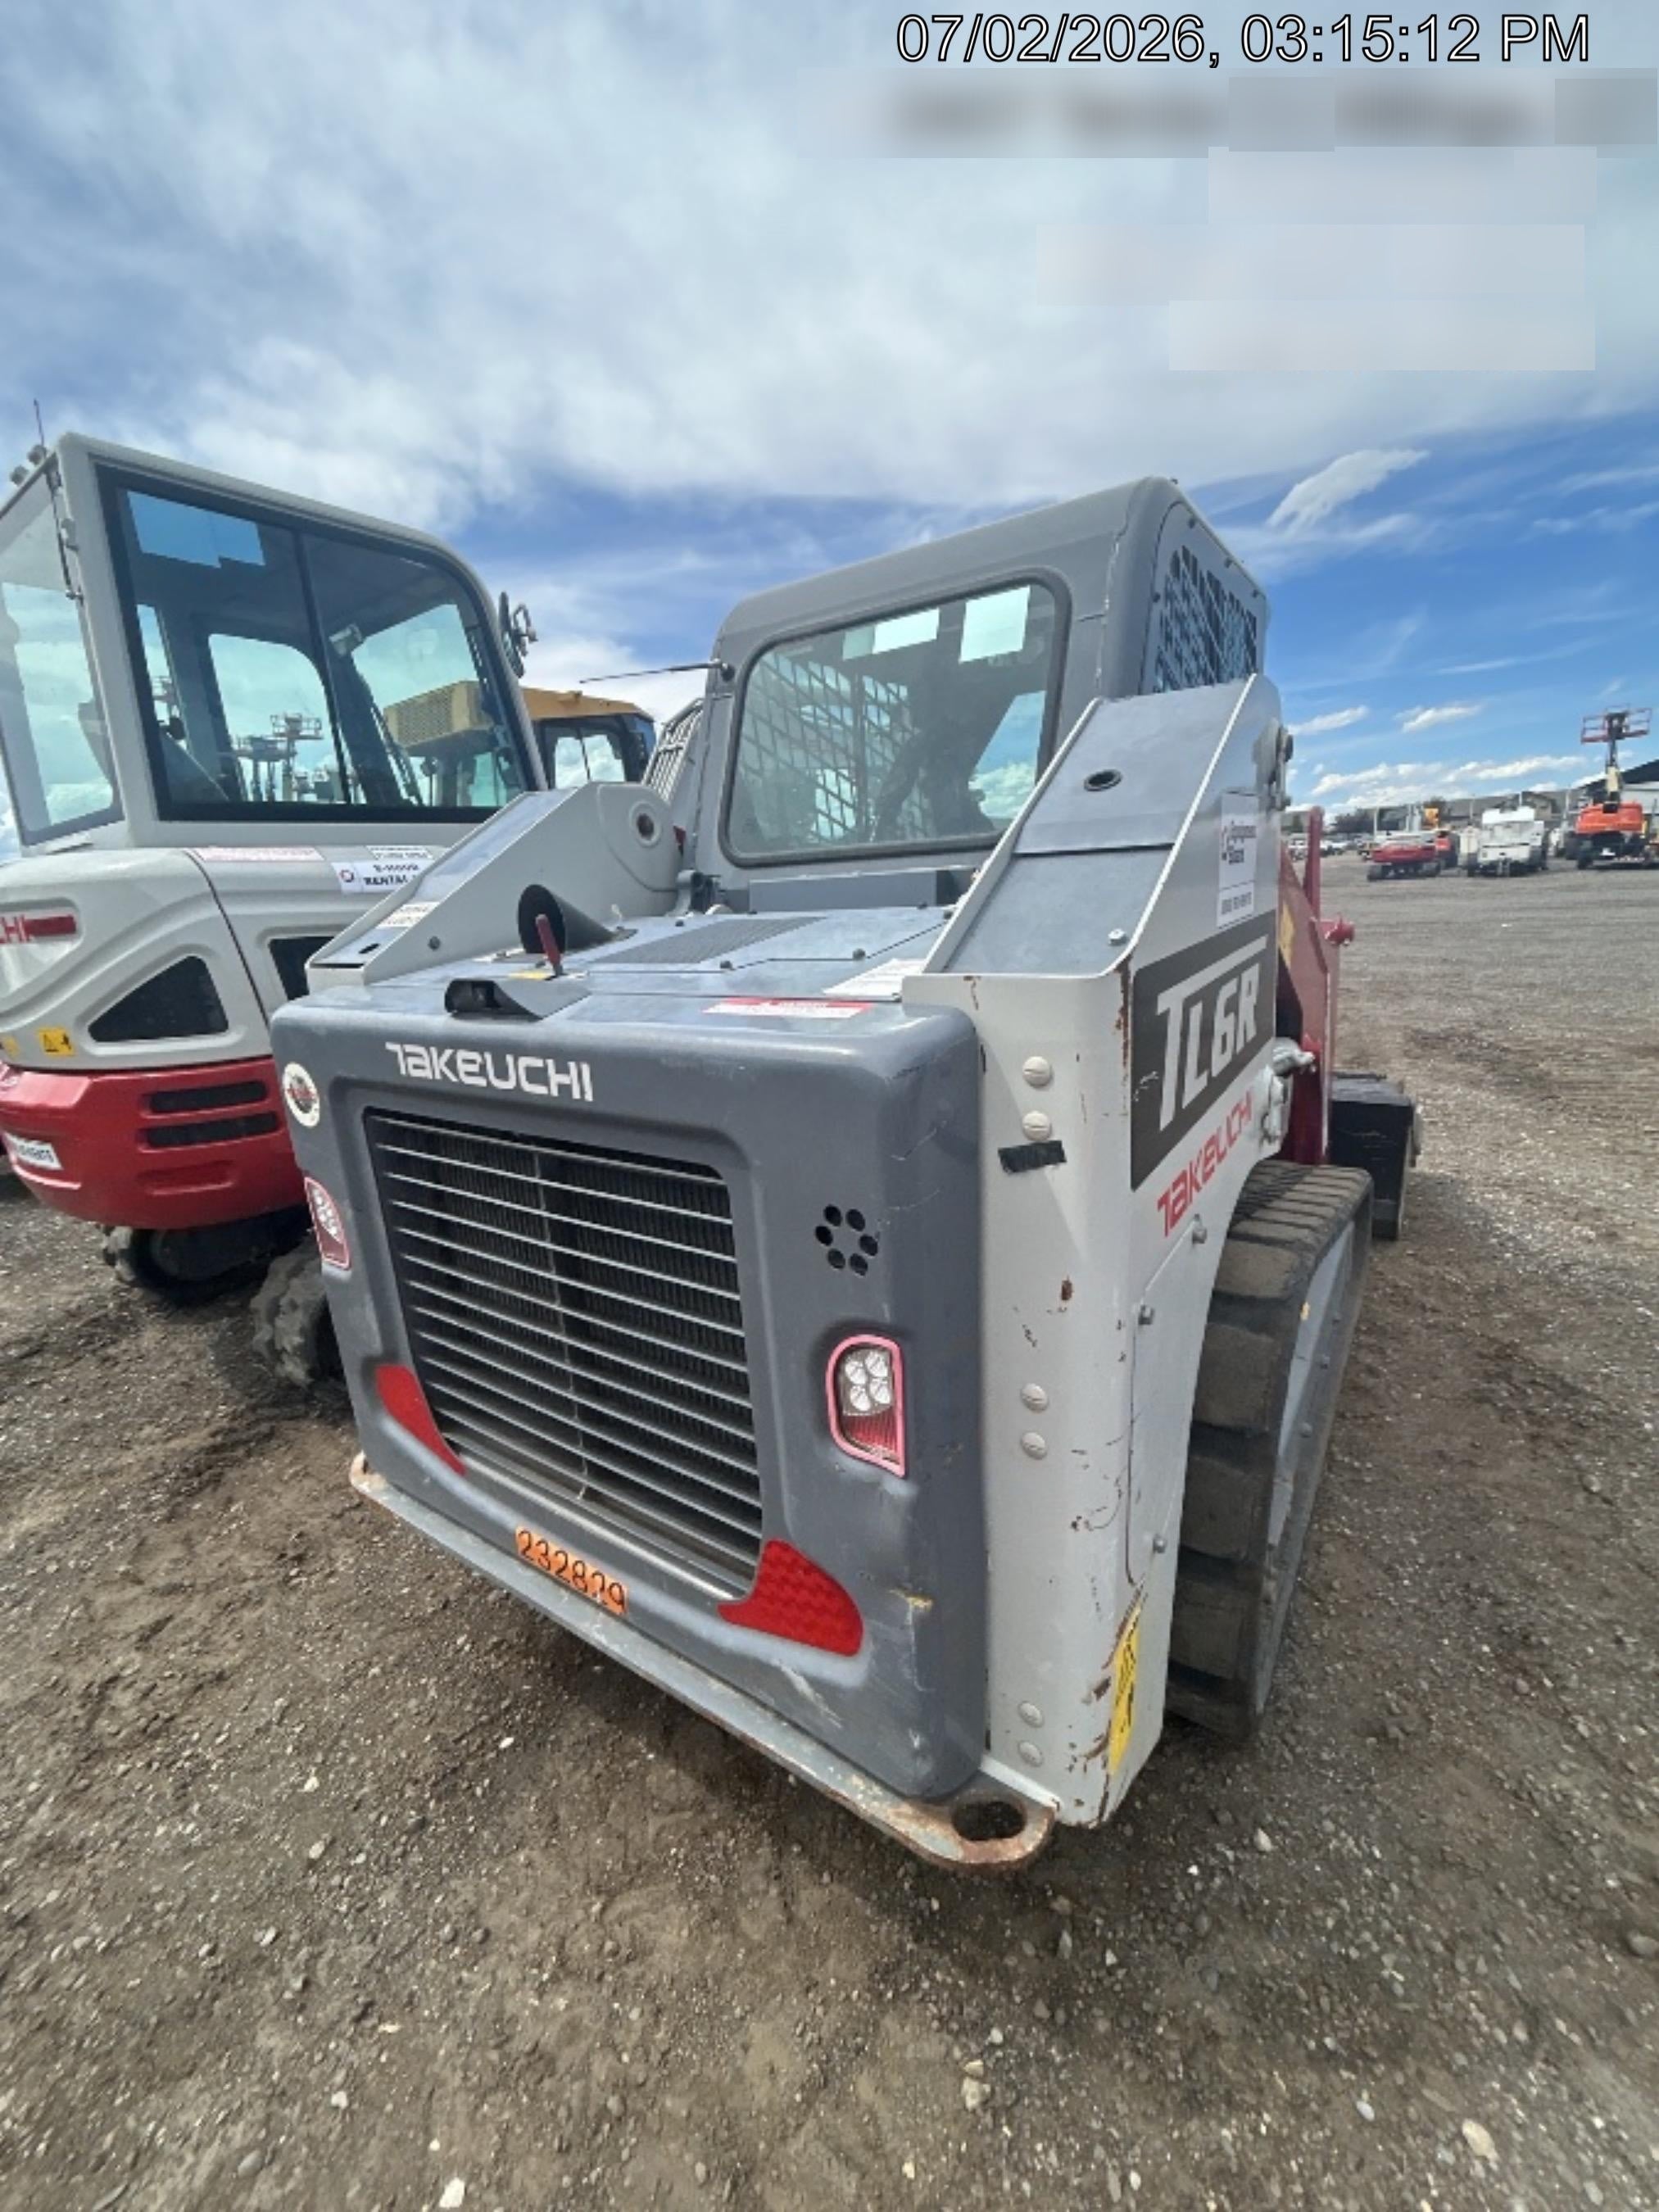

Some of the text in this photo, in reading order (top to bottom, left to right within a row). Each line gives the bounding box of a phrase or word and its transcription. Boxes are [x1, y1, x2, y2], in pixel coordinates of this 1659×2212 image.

[0, 914, 30, 944] HI
[385, 1041, 594, 1102] TAKEUCHI
[1157, 935, 1268, 1132] TL6R
[1157, 1089, 1254, 1237] TAKEUCHI
[517, 1529, 628, 1616] 232829
